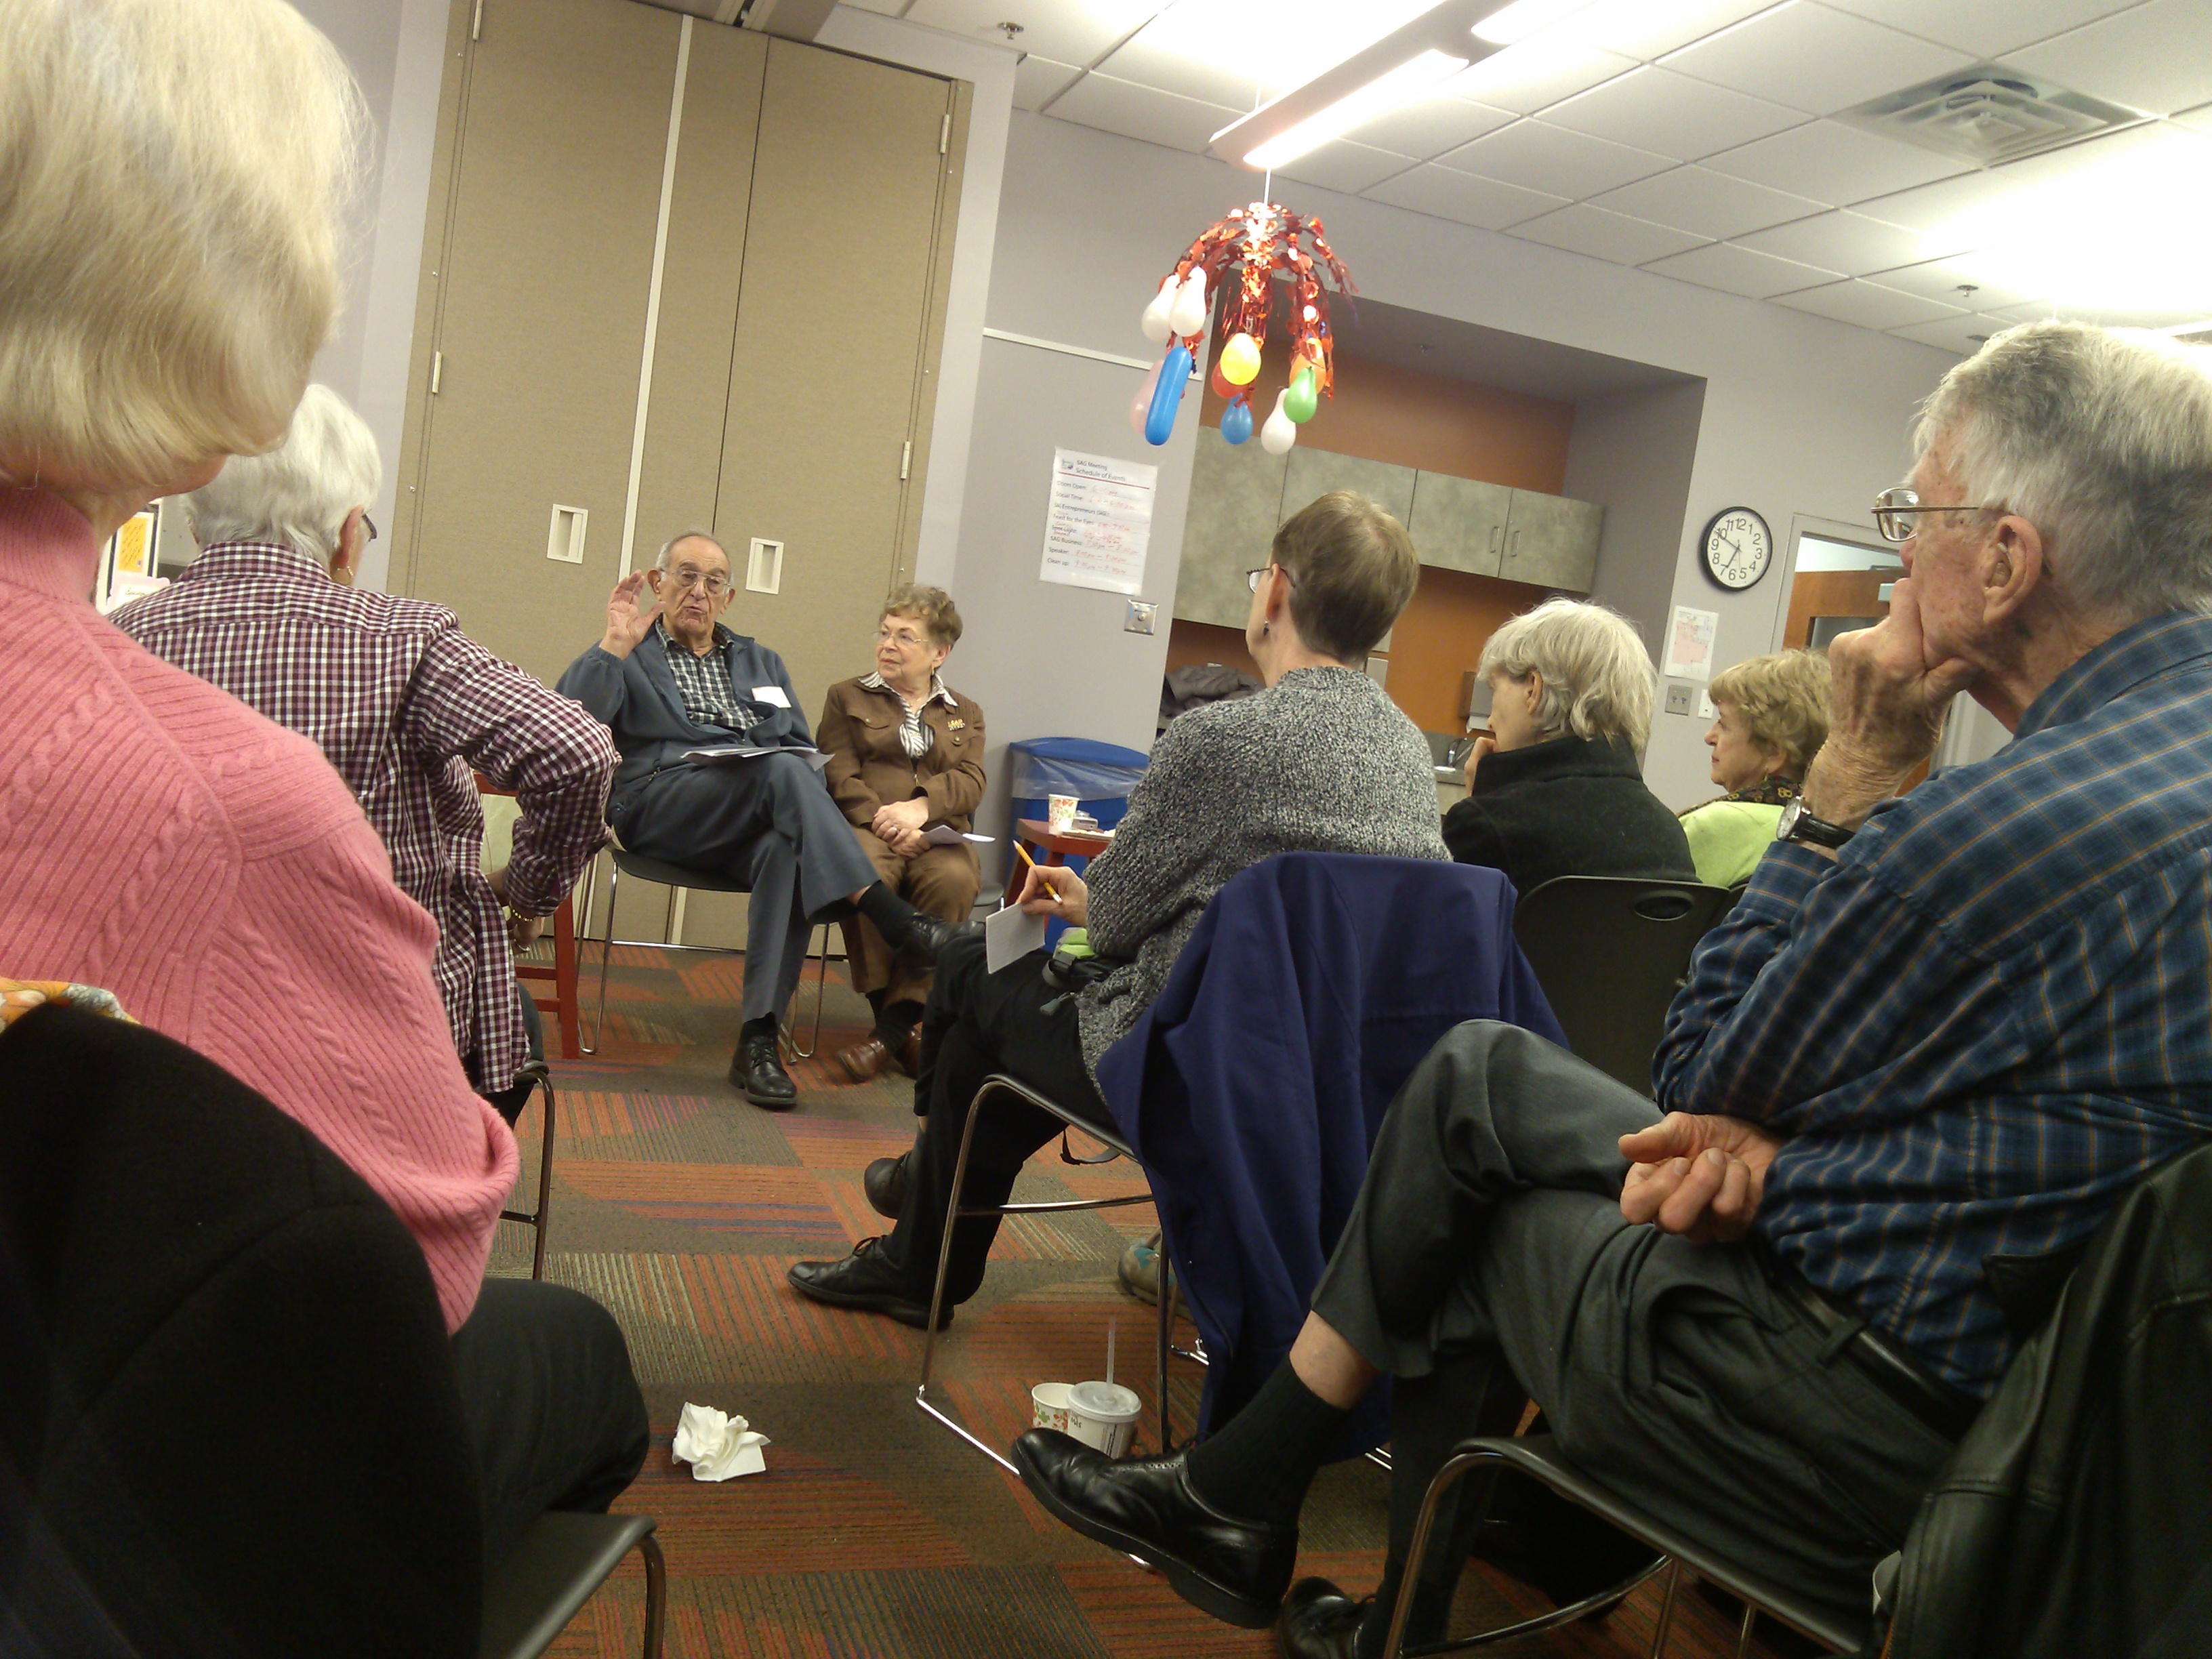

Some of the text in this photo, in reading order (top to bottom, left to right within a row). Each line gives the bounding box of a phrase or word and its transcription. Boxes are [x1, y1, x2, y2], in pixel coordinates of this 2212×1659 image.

[1076, 468, 1101, 476] Schedule
[1087, 462, 1107, 471] Meeting
[1726, 519, 1734, 531] 11
[1735, 518, 1746, 531] 12
[1748, 523, 1753, 535] 1
[1716, 527, 1727, 540] 10
[1753, 533, 1761, 545] 2
[1711, 539, 1719, 551] 9
[1712, 552, 1720, 565] 8
[1755, 548, 1762, 559] 3
[1720, 564, 1728, 576] 7
[1749, 560, 1756, 572] 4
[1728, 568, 1736, 580] 6
[1739, 567, 1747, 579] 5
